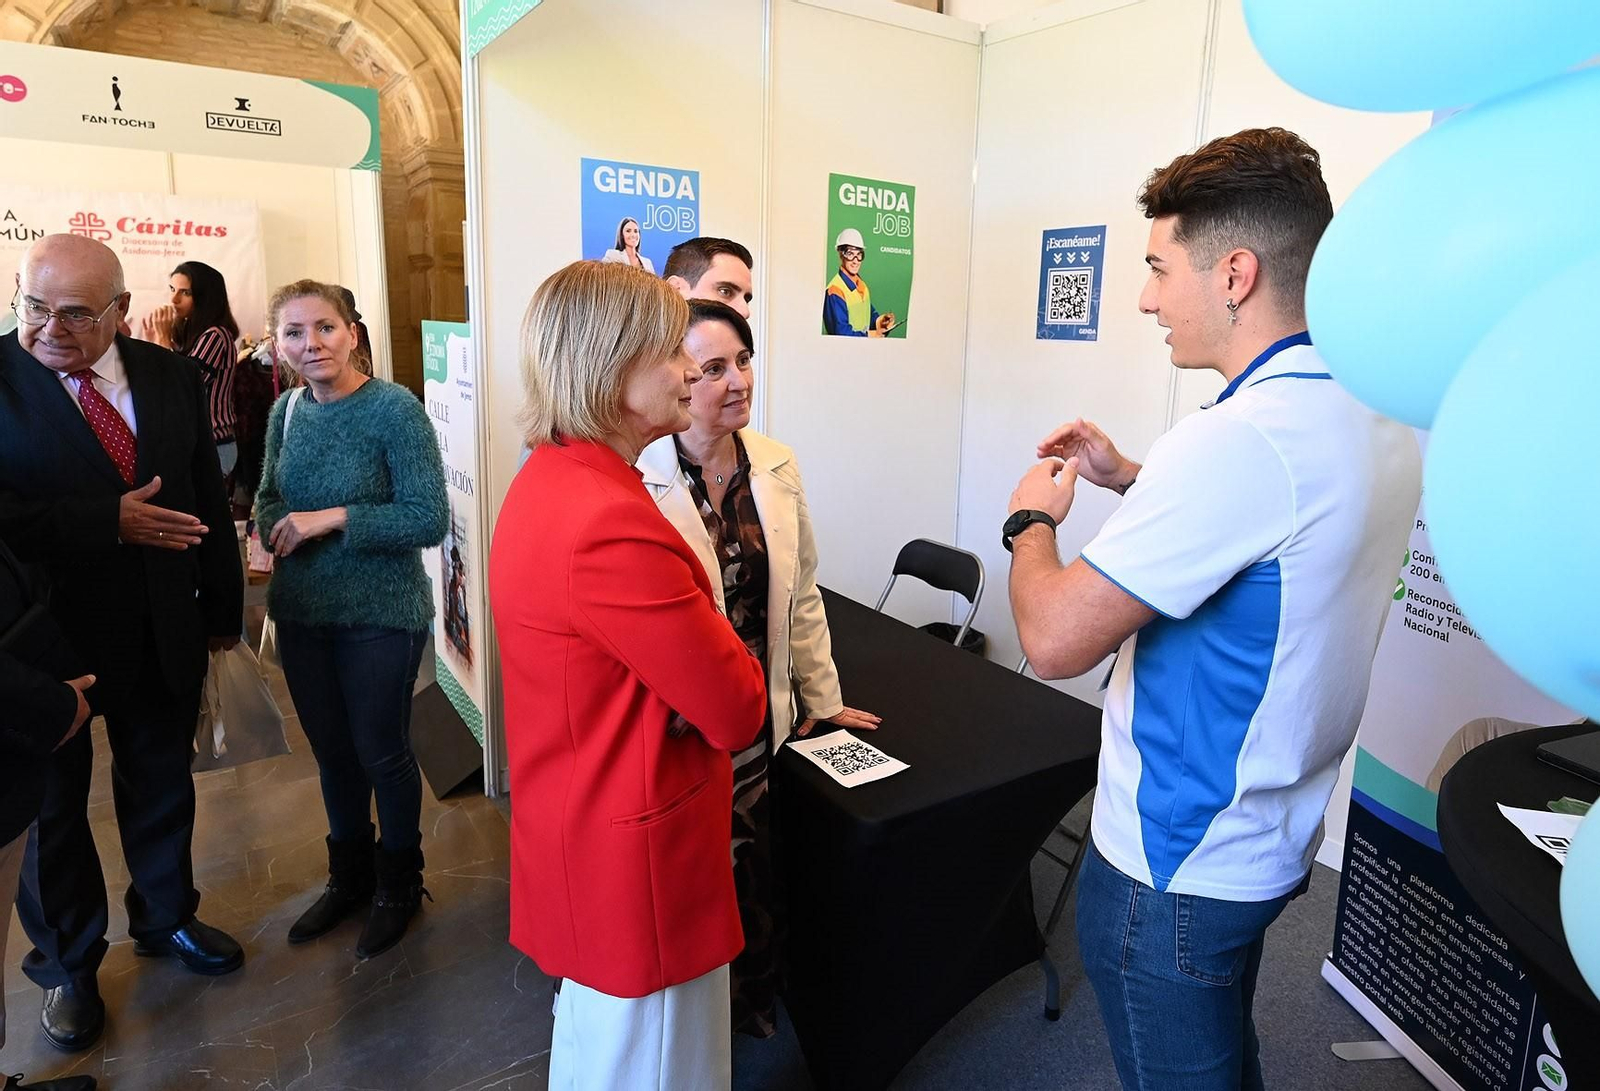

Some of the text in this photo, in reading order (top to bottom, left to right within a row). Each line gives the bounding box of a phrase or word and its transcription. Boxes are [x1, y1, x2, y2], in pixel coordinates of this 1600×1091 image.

[593, 165, 695, 201] GENDA
[839, 183, 910, 213] GENDA
[0, 223, 44, 241] MÚN
[116, 217, 227, 237] Cáritas
[642, 204, 696, 233] JOB
[873, 212, 911, 237] JOB
[121, 237, 183, 247] Diocesana de
[122, 247, 186, 257] Asidonia-Jerez
[1046, 234, 1101, 252] ¡Escanéame!
[429, 399, 450, 424] CALLE
[1416, 519, 1428, 532] Pr
[1410, 564, 1430, 579] 200
[1412, 550, 1439, 567] Conf
[1405, 602, 1434, 622] Radio
[1436, 614, 1444, 626] y
[1403, 617, 1450, 643] Nacional
[1353, 832, 1508, 950] Somos una plataforma dedicada
[1350, 859, 1483, 965] profesionales en busca de empleo.
[1352, 846, 1526, 980] simplificar la conexión entre empresas y
[1348, 884, 1518, 1025] en Genda Job recibirán tanto candidatos
[1349, 870, 1520, 1010] Las empresas que publiquen sus ofertas
[1345, 907, 1513, 1055] inscriban a su oferta. Para publicar una
[1346, 896, 1516, 1040] cualificados como todos aquellos que se
[1339, 957, 1405, 1023] nuestro portal web.
[1341, 943, 1358, 964] Todo
[1359, 962, 1371, 976] ello
[1372, 975, 1382, 986] en
[1383, 984, 1393, 995] un
[1394, 994, 1424, 1024] entorno
[1425, 1020, 1459, 1056] intuitivo
[1461, 1055, 1492, 1086] dentro
[1342, 933, 1378, 969] plataforma
[1380, 967, 1390, 979] en
[1450, 1028, 1456, 1037] y
[1458, 1036, 1509, 1086] registrarse.
[1368, 942, 1383, 958] solo
[1385, 958, 1423, 993] necesitan
[1426, 993, 1461, 1025] acceder
[1465, 1026, 1471, 1035] a
[1475, 1035, 1511, 1070] nuestra
